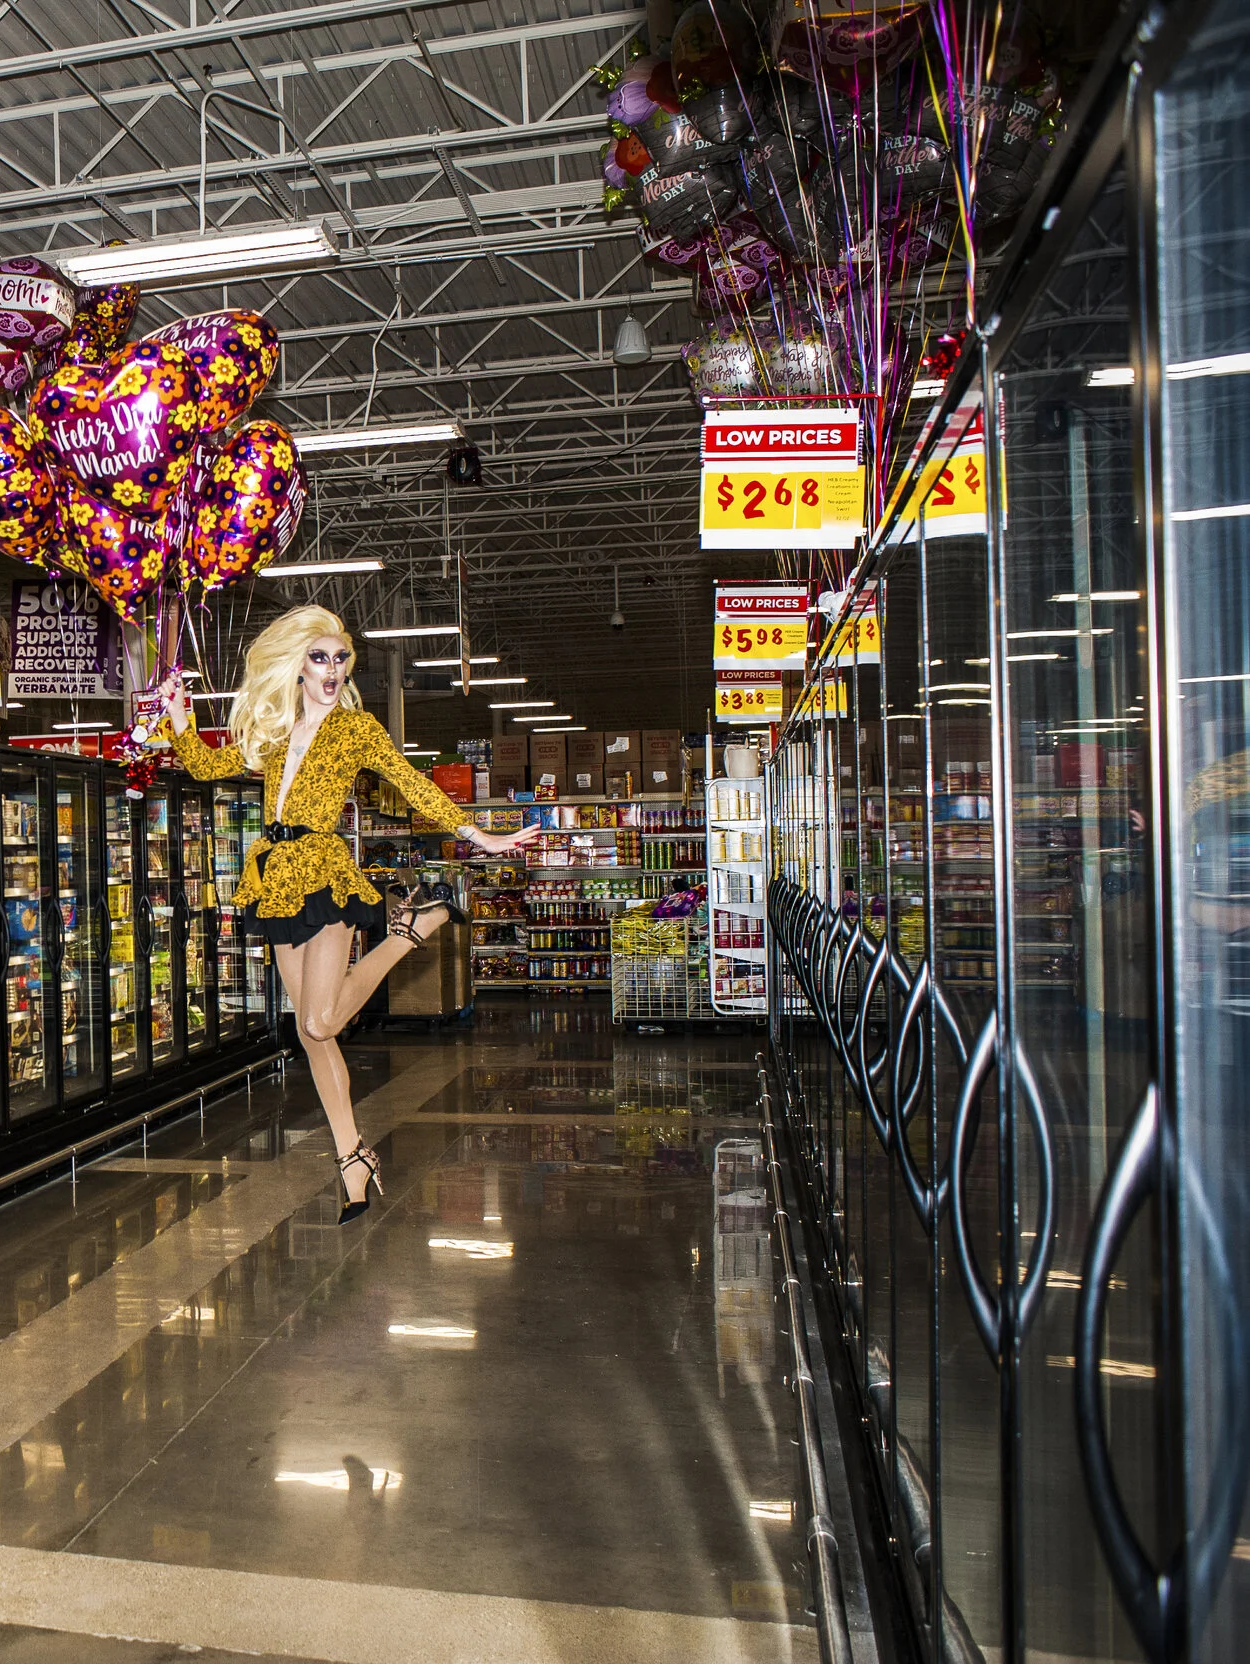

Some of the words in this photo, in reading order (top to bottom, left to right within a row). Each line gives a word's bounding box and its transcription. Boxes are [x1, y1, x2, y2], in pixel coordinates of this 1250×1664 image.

[694, 139, 716, 150] DA
[661, 184, 686, 201] DAY
[715, 430, 765, 446] LOW
[768, 429, 842, 446] PRICES
[18, 585, 100, 614] 50%
[724, 598, 753, 608] LOW
[756, 598, 800, 609] PRICES
[16, 615, 98, 630] PROFITS
[16, 631, 98, 645] SUPPORT
[15, 646, 97, 658] ADDICTION
[14, 658, 96, 671] RECOVERY
[14, 676, 49, 684] ORGANIC
[721, 671, 743, 679] LOW
[744, 671, 776, 679] PRICES
[15, 684, 58, 694] YERBA
[59, 684, 96, 694] MATE
